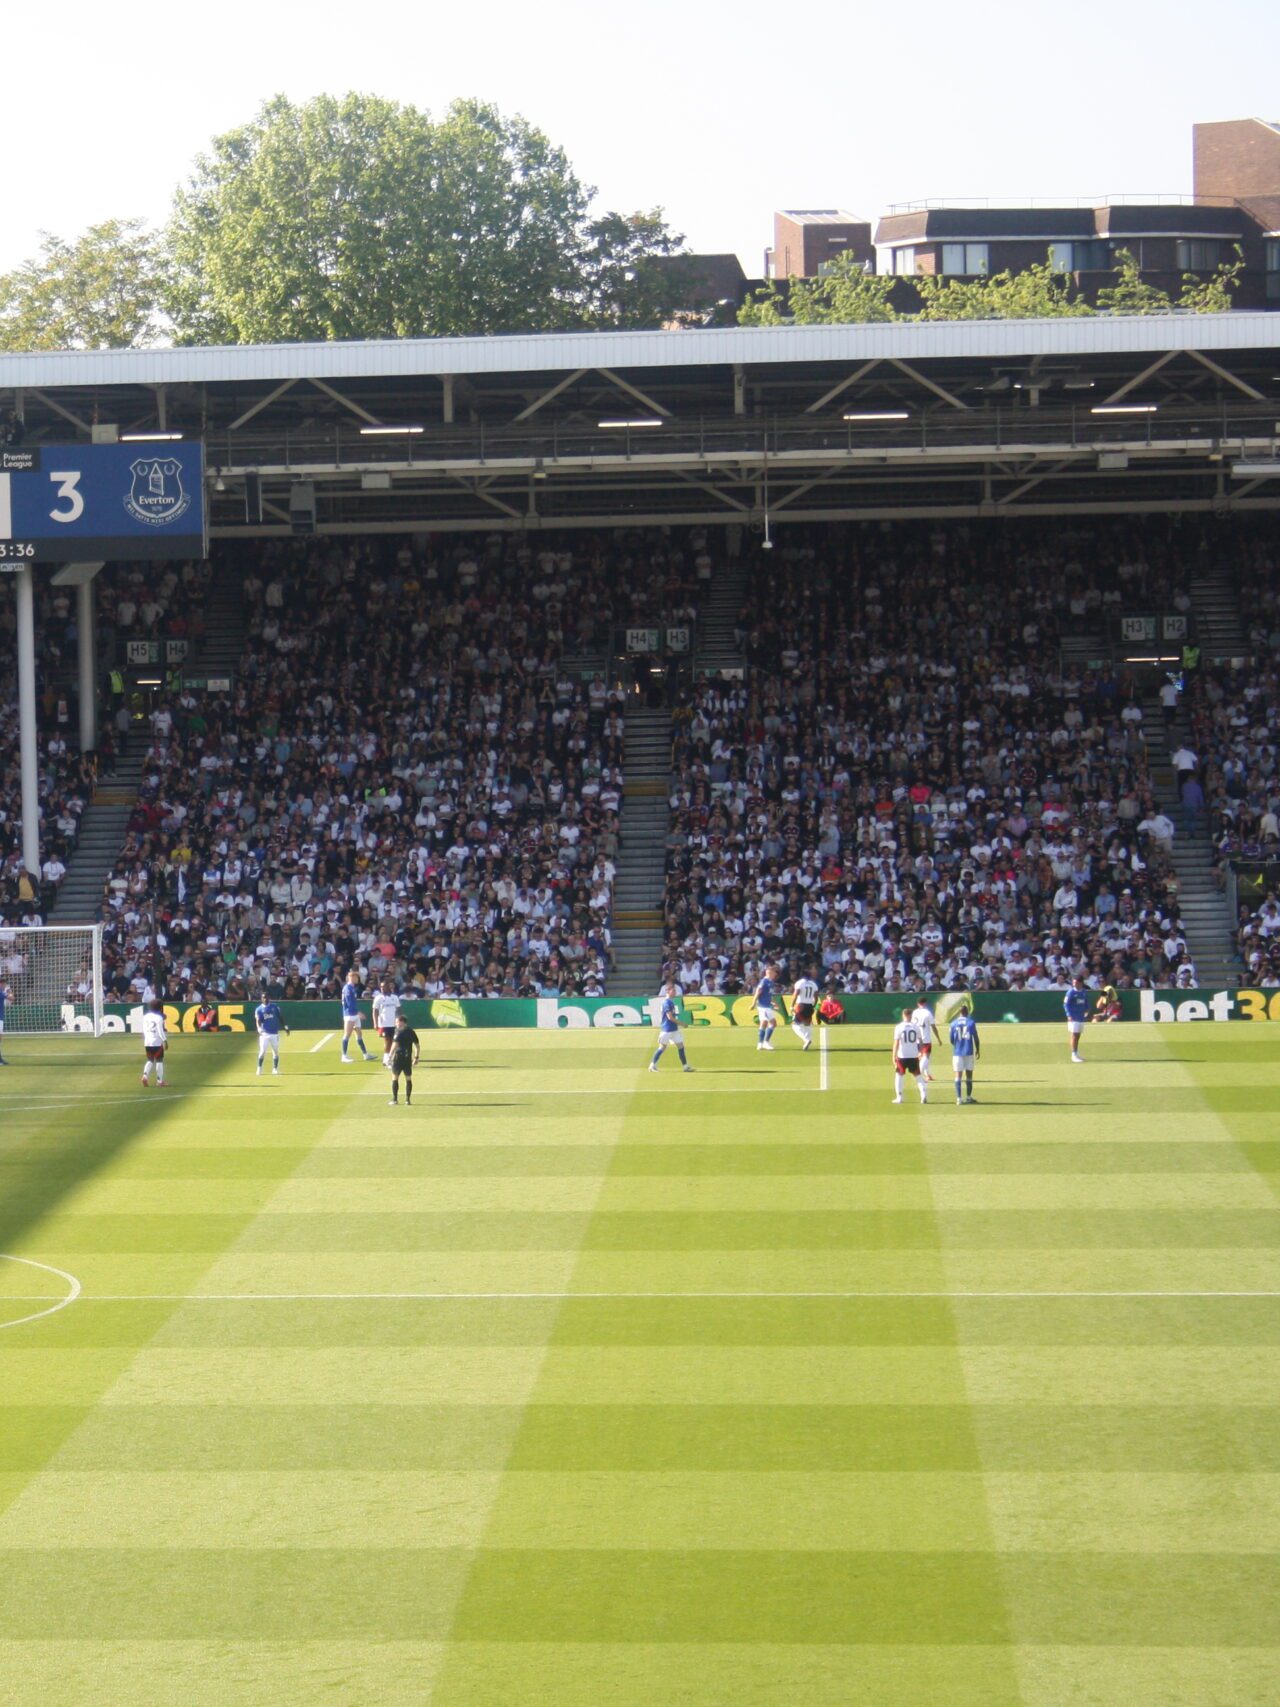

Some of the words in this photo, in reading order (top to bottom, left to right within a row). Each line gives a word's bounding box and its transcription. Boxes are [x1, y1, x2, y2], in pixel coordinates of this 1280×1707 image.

[3, 453, 33, 461] Premier
[3, 461, 33, 469] League
[49, 472, 85, 523] 3
[139, 496, 175, 504] Everton
[1126, 620, 1143, 633] H3
[1166, 619, 1184, 632] H2
[631, 631, 647, 645] H4
[670, 630, 688, 644] H3
[131, 643, 148, 657] H5
[169, 643, 185, 656] H4
[805, 986, 813, 998] 11
[902, 1030, 917, 1044] 10
[955, 1026, 970, 1041] 14
